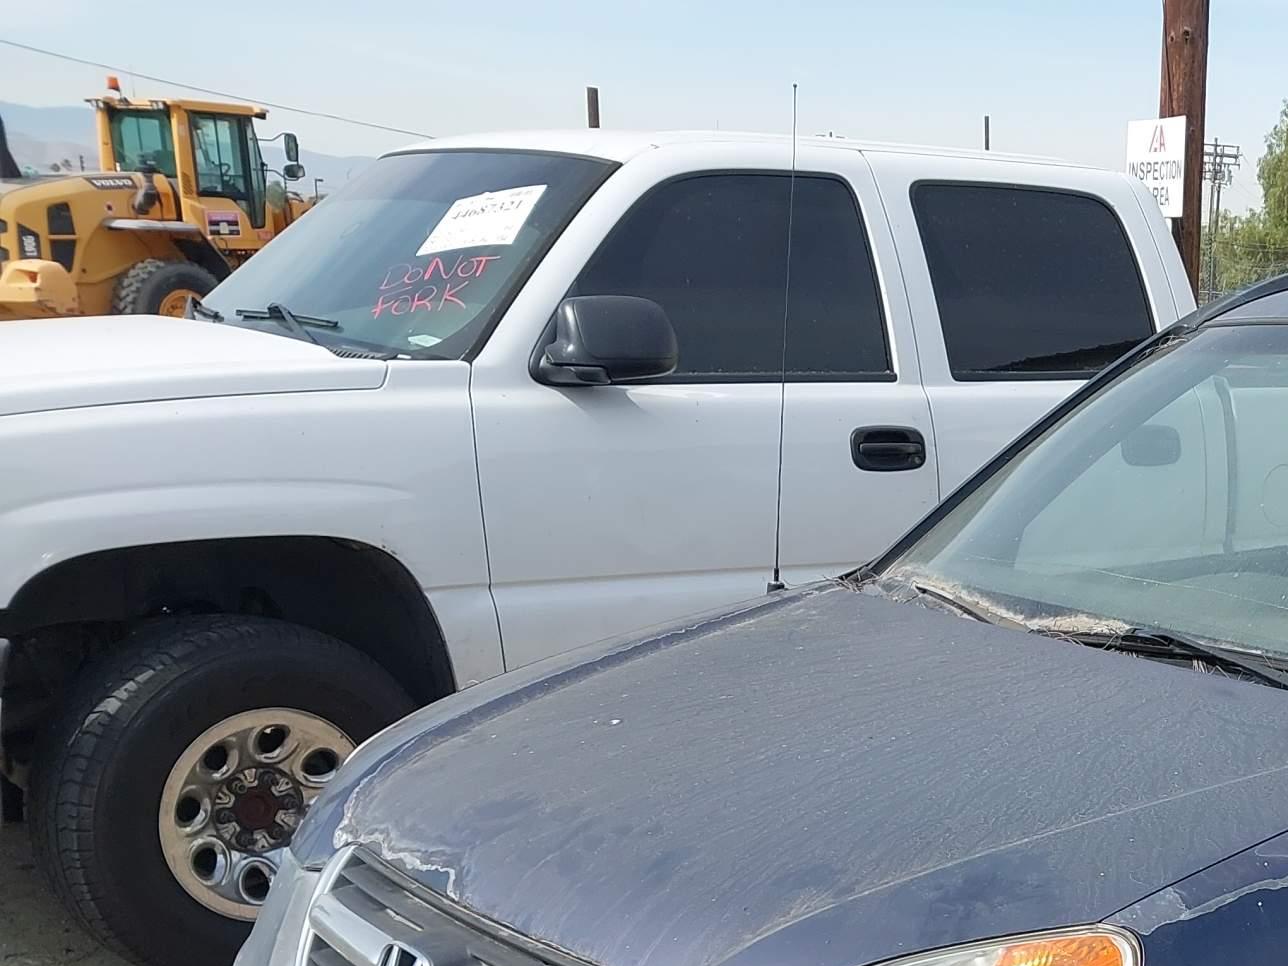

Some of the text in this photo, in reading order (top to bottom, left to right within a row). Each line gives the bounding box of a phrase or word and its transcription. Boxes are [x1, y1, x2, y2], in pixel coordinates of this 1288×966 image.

[1128, 159, 1183, 181] INSPECTION
[91, 178, 133, 187] VOLVO
[1147, 185, 1170, 206] REA
[370, 280, 470, 320] FORK
